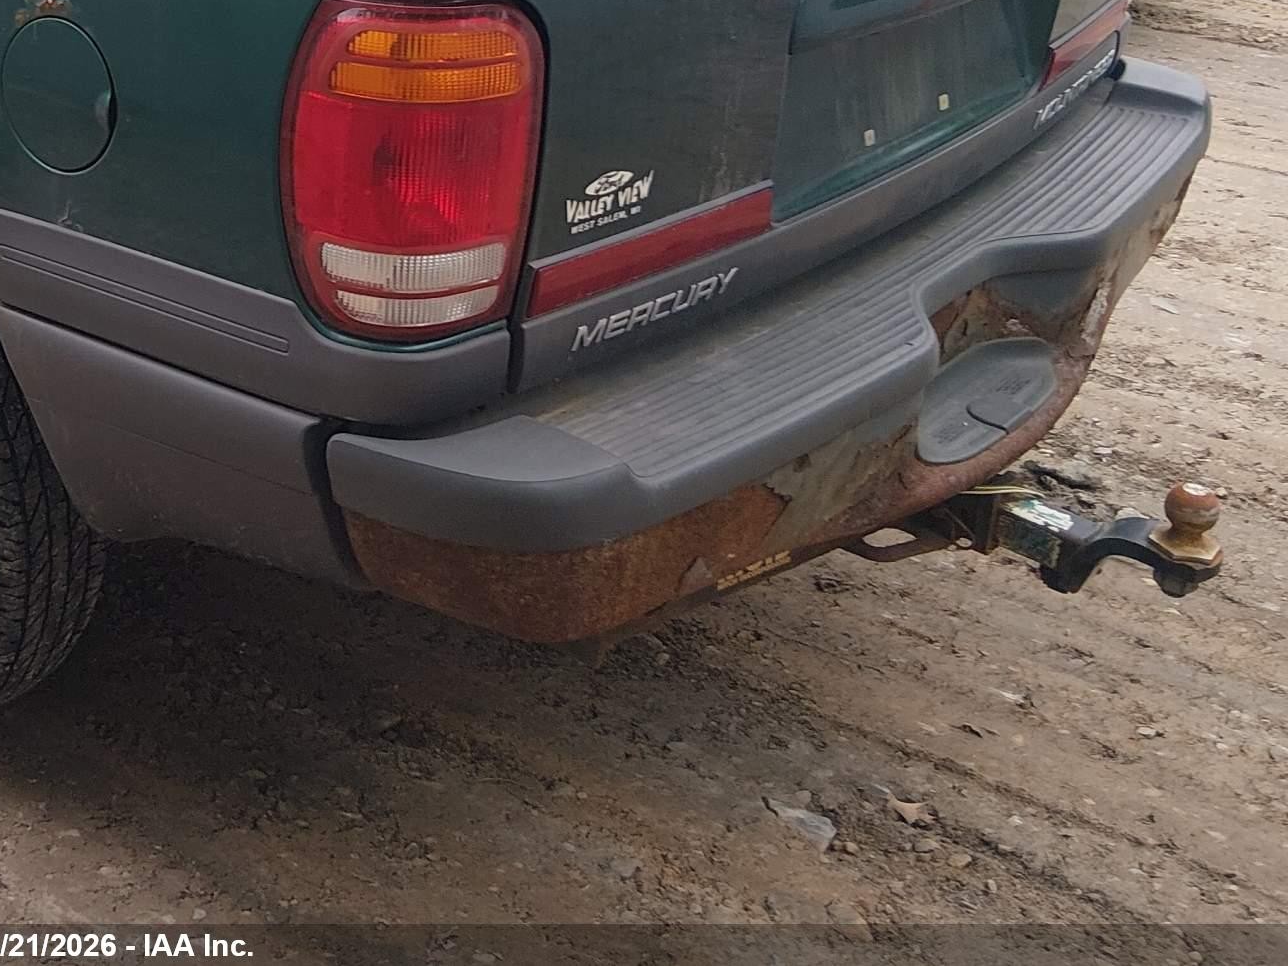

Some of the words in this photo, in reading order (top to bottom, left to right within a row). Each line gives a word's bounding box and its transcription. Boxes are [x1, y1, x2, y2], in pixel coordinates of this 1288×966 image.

[566, 193, 615, 224] VALLEY
[617, 169, 655, 207] VIEW
[570, 220, 596, 235] WEST
[570, 266, 740, 353] MERCURY
